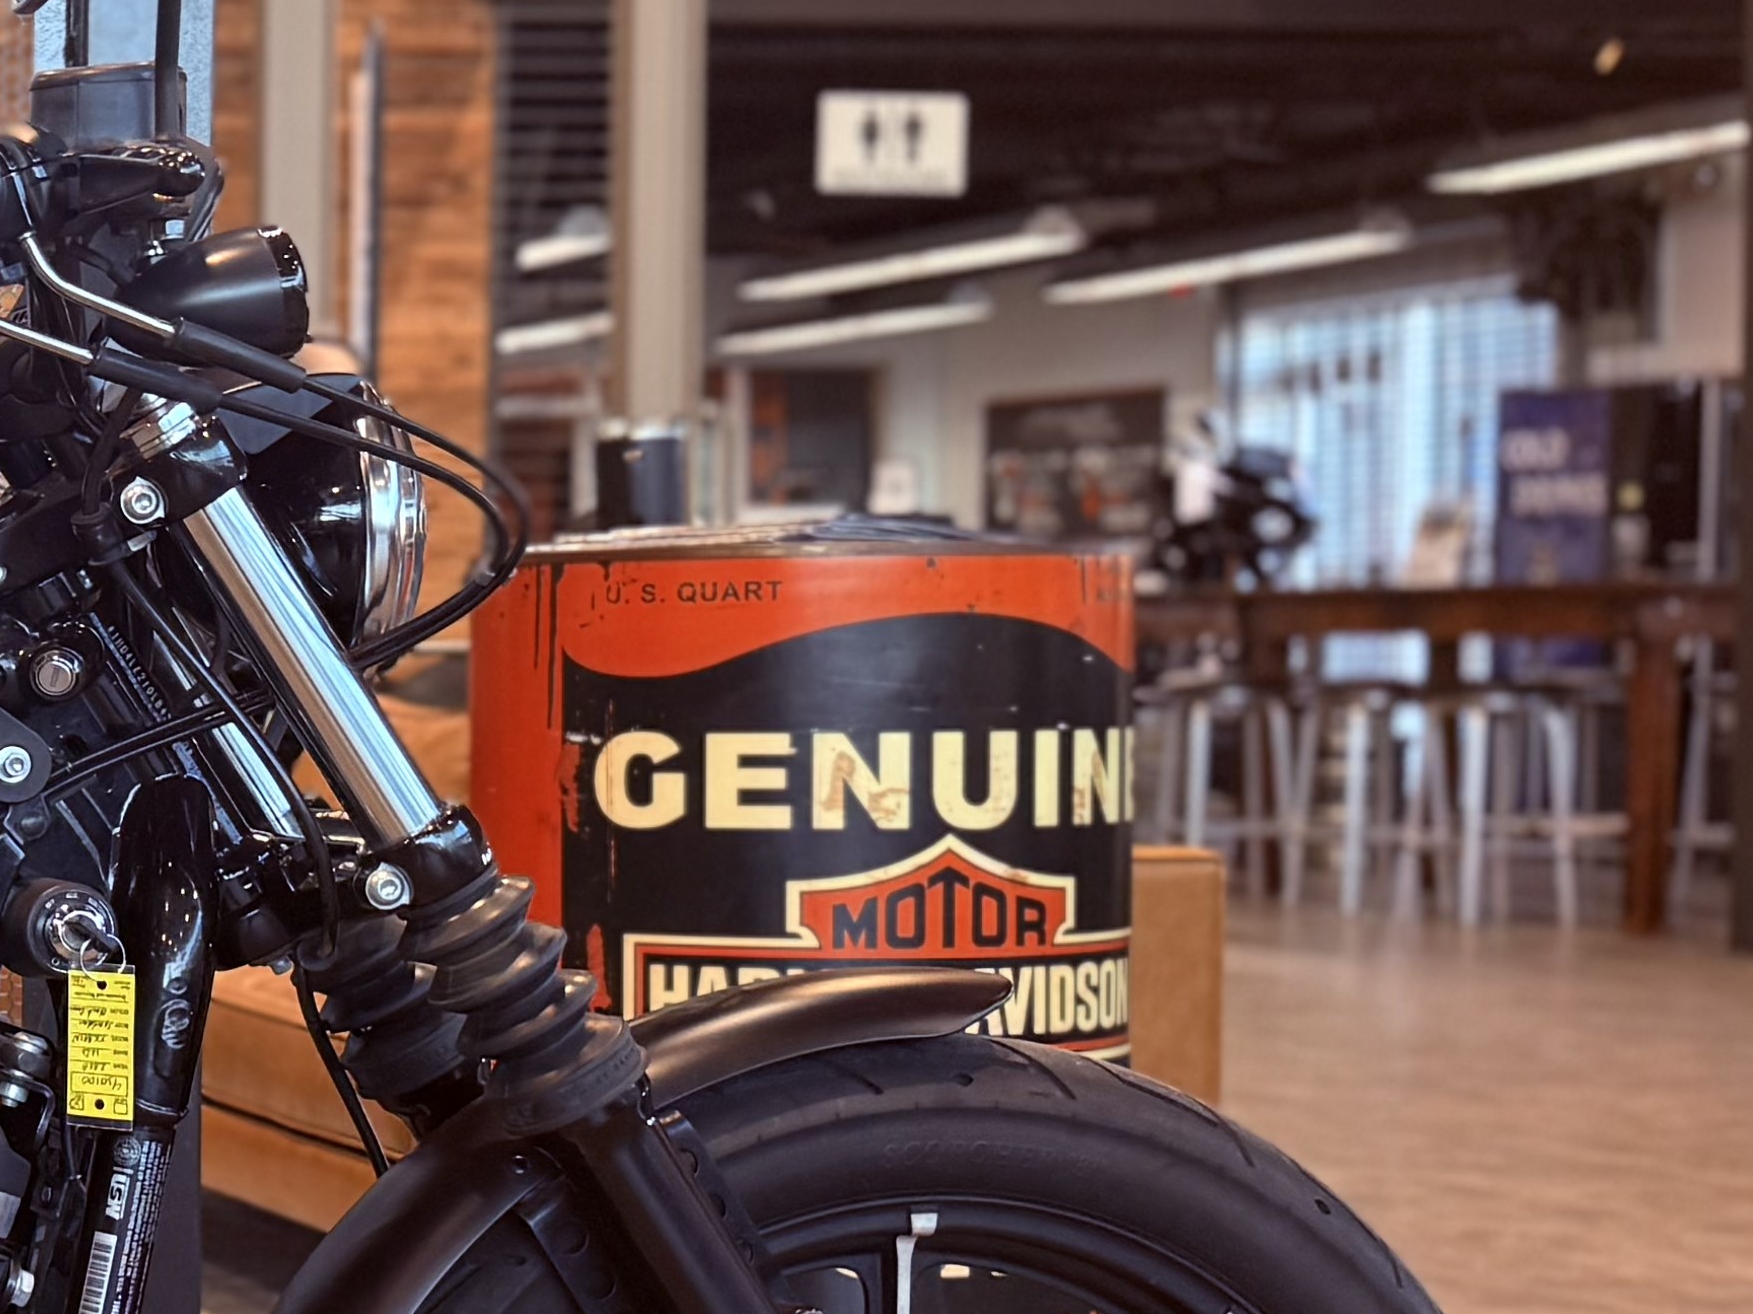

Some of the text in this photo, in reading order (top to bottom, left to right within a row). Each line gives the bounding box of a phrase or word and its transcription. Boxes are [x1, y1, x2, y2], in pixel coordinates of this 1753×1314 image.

[642, 582, 666, 605] S.
[677, 580, 783, 604] QUART
[832, 866, 1047, 950] MOTOR
